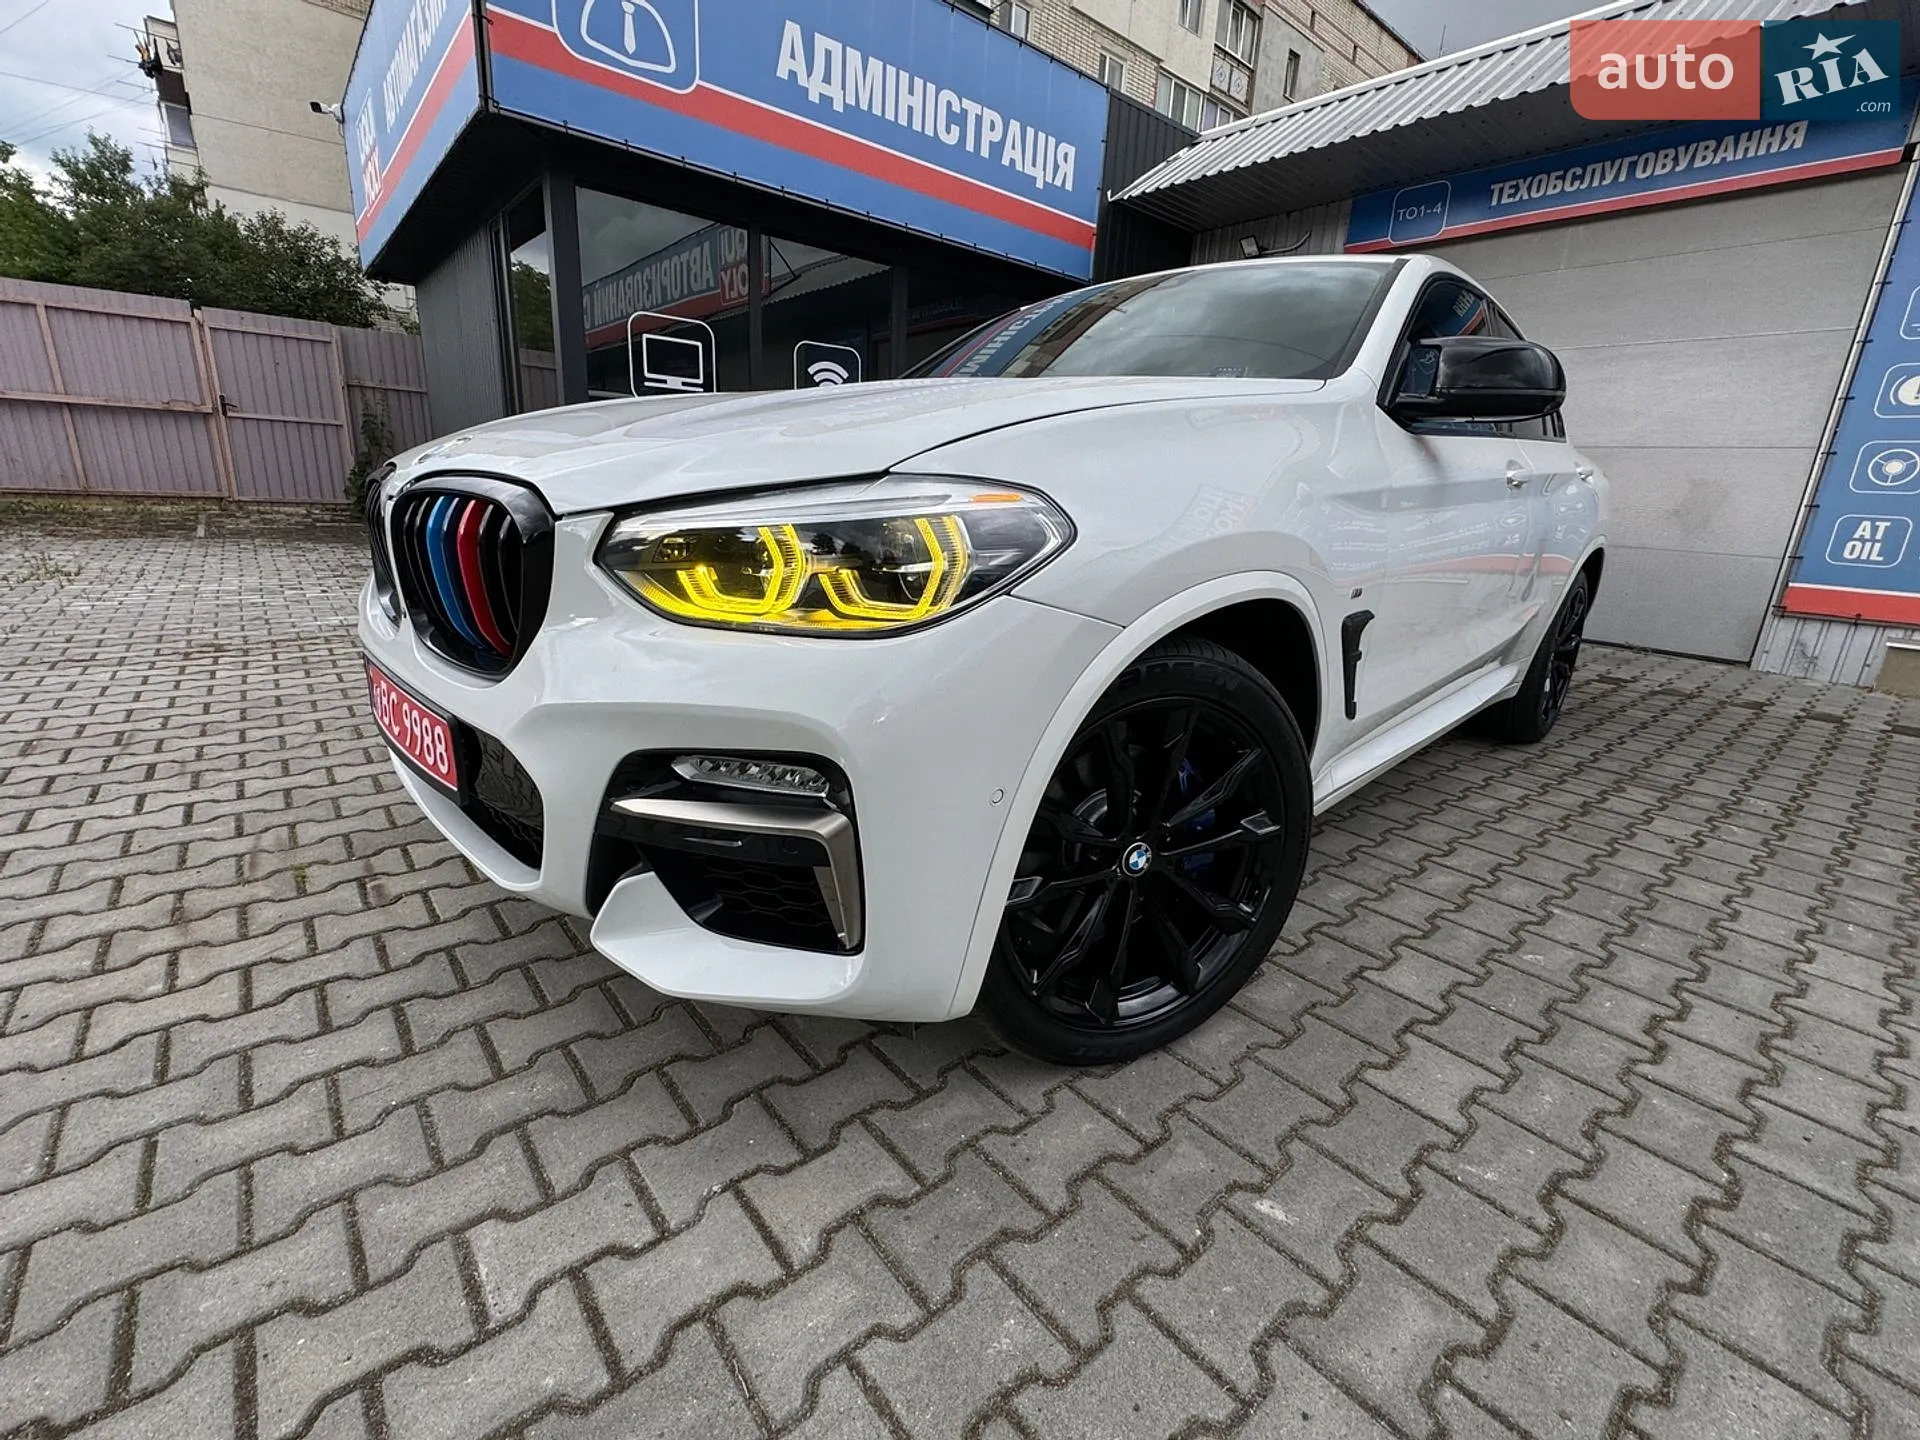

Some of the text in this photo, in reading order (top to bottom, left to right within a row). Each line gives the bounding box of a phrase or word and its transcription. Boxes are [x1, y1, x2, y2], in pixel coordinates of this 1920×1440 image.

[776, 19, 1076, 191] АДМІНІСТРАЦІЯ
[1490, 120, 1808, 207] ТЕХОБСЛУГОВУВАННЯ
[1843, 541, 1884, 561] OIL
[1853, 521, 1891, 540] AT
[402, 702, 449, 775] 9988
